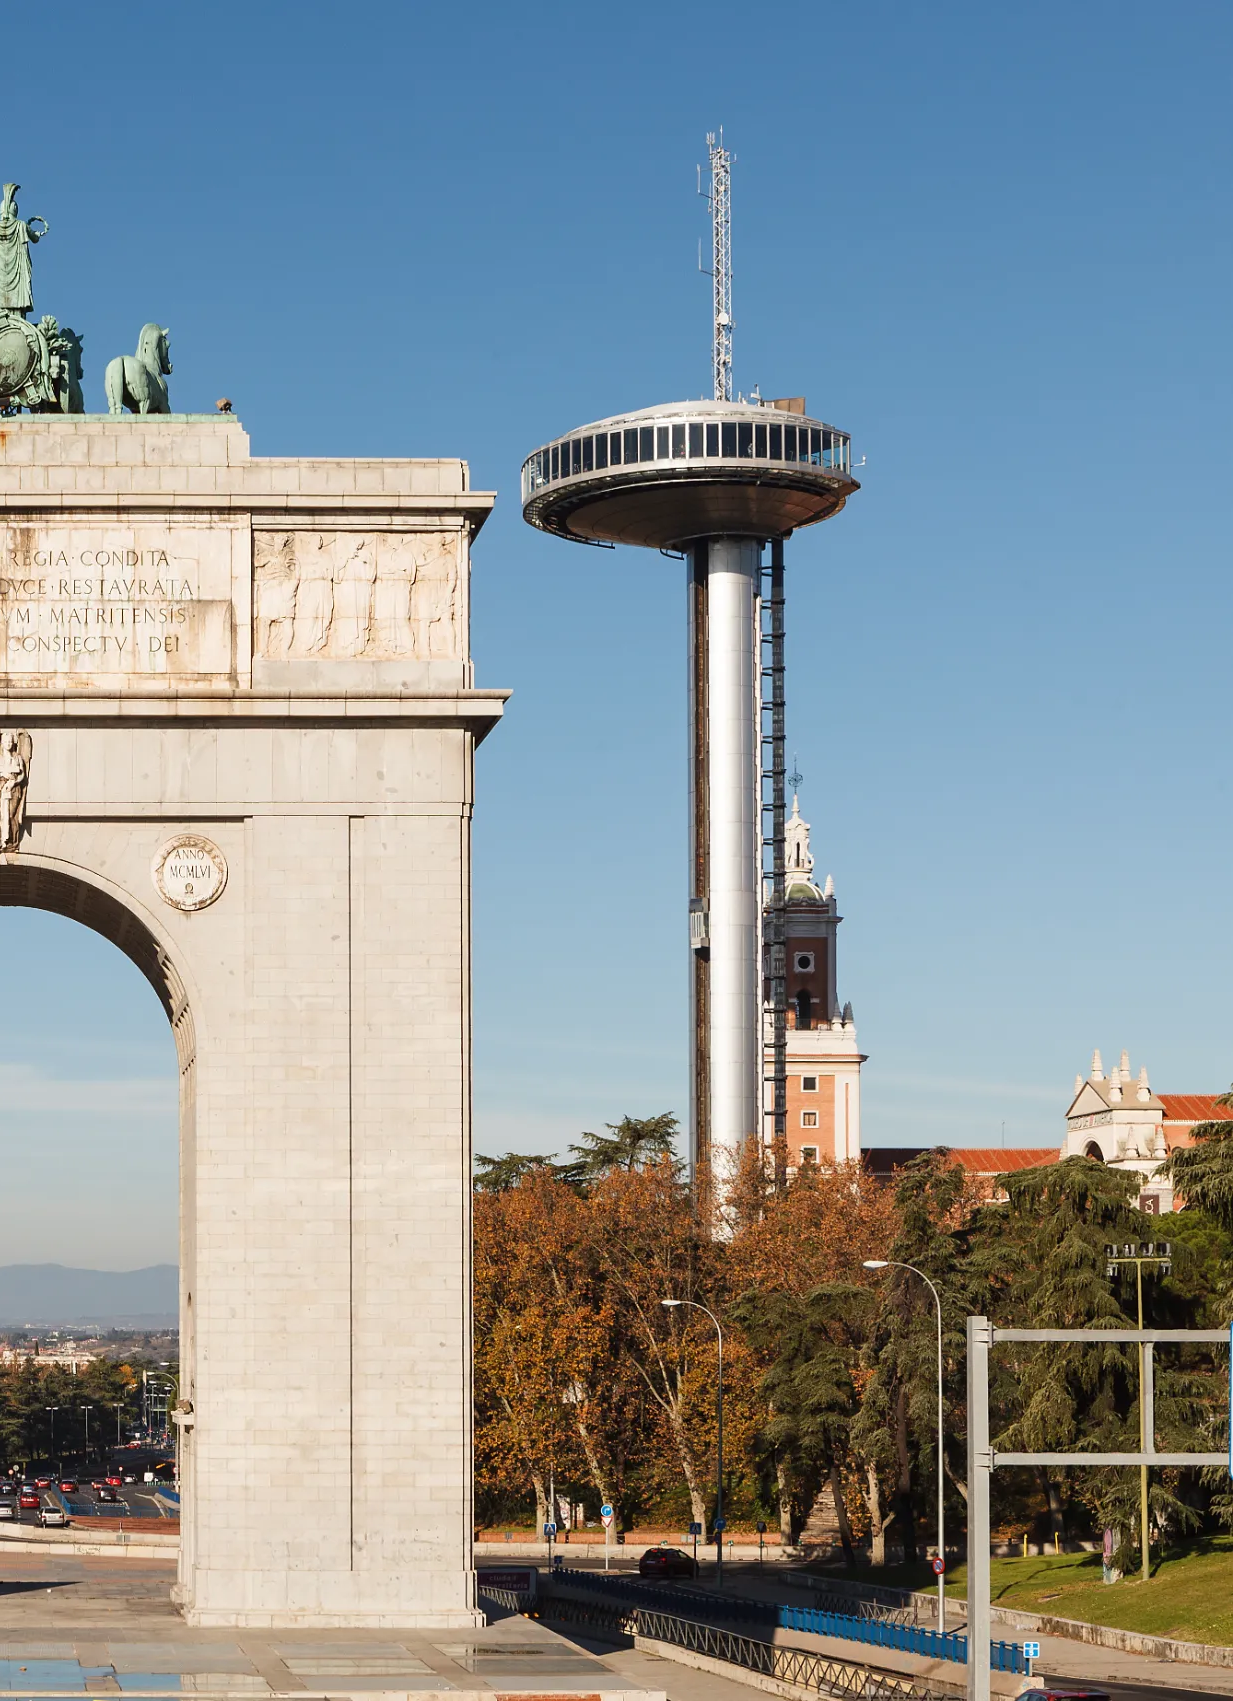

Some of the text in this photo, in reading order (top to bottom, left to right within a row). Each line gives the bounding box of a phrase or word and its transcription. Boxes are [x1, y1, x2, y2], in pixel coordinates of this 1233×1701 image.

[9, 550, 69, 567] REGIA
[79, 550, 170, 567] CONDITA
[58, 579, 194, 595] RESTAVRATA
[50, 607, 187, 624] MATRITENSIS
[7, 636, 128, 653] CONSPECTV
[149, 636, 180, 653] DEI
[174, 849, 205, 860] ANNO
[170, 865, 211, 878] MCMLVI
